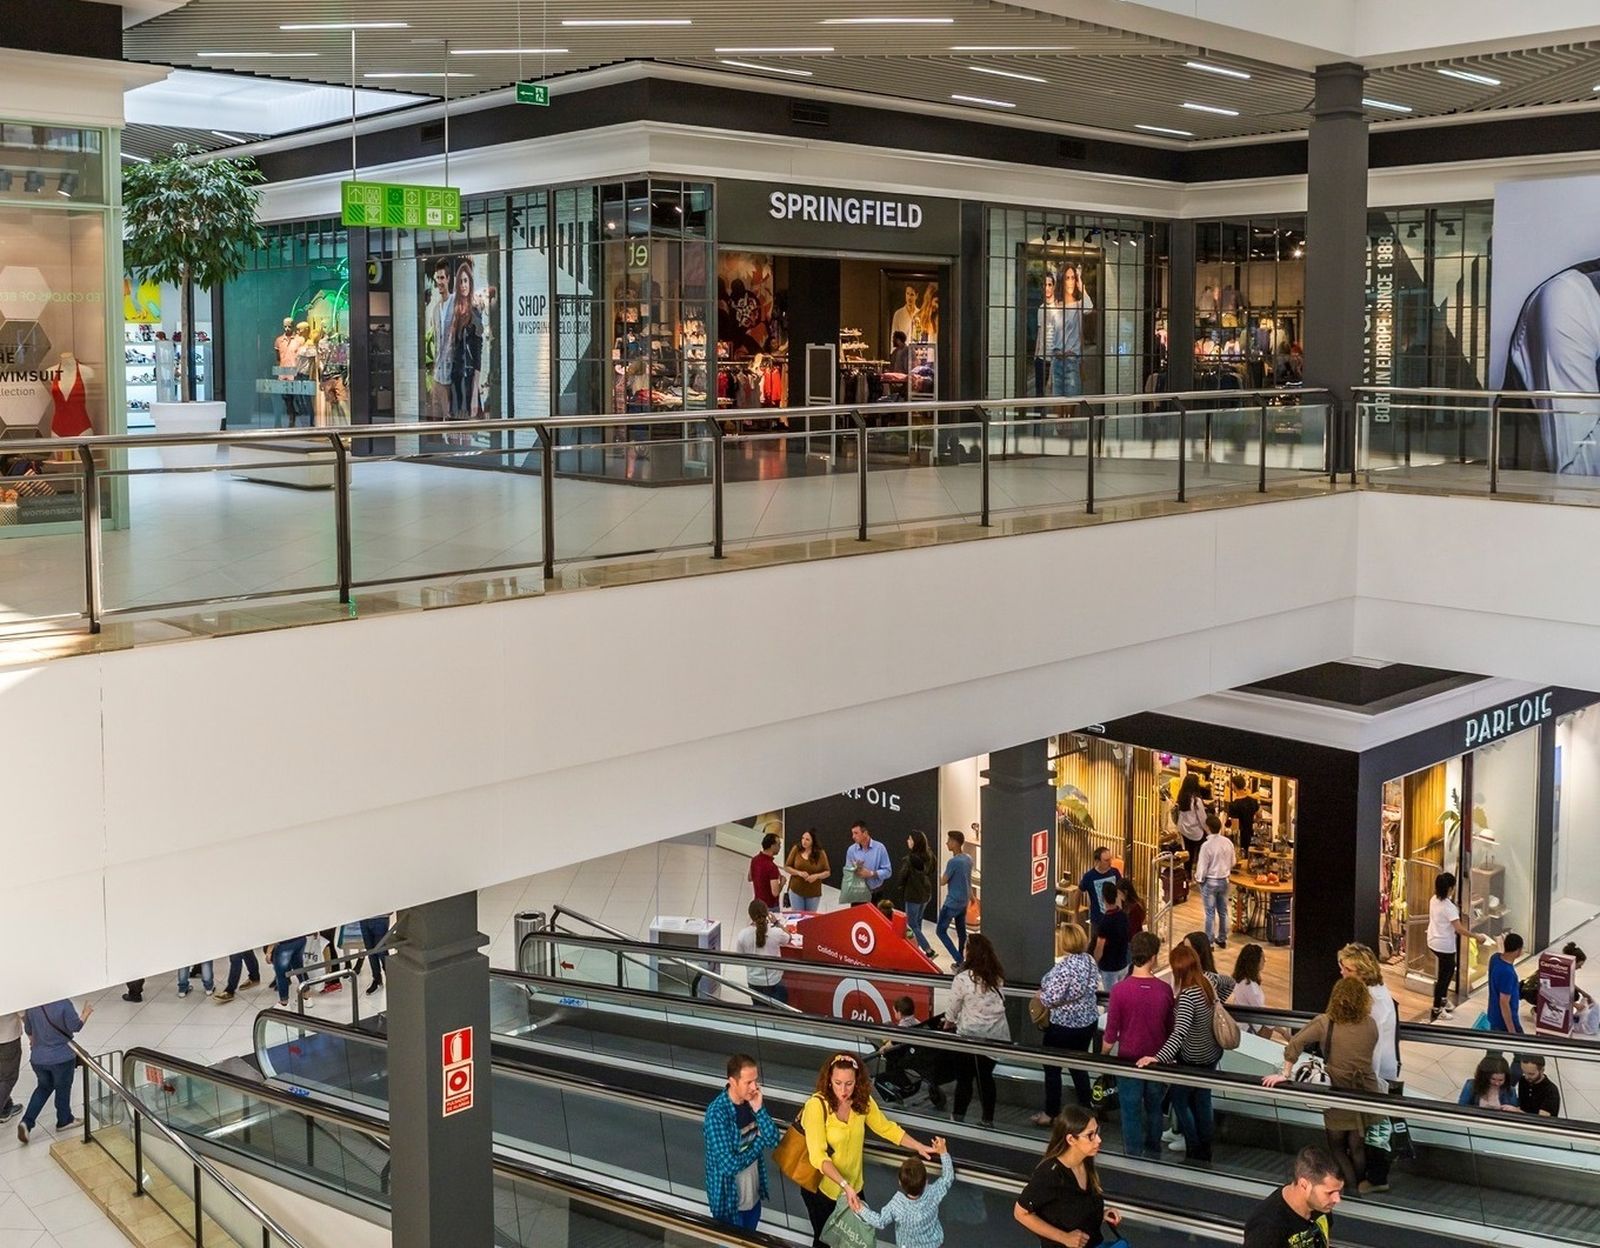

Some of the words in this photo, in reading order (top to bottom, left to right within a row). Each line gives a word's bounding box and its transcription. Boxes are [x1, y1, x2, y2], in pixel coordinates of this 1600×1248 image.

[769, 191, 923, 229] SPRINGFIELD
[1377, 232, 1394, 269] 1988.
[518, 295, 546, 316] SHOP
[559, 299, 589, 316] NLINE
[1376, 273, 1393, 312] SINCE
[1376, 314, 1393, 368] EUROPE.
[0, 352, 15, 364] HE
[0, 370, 64, 382] WIMSUIT
[1375, 371, 1391, 384] IN
[1375, 393, 1390, 422] BOR
[1465, 691, 1553, 747] PARFOIS
